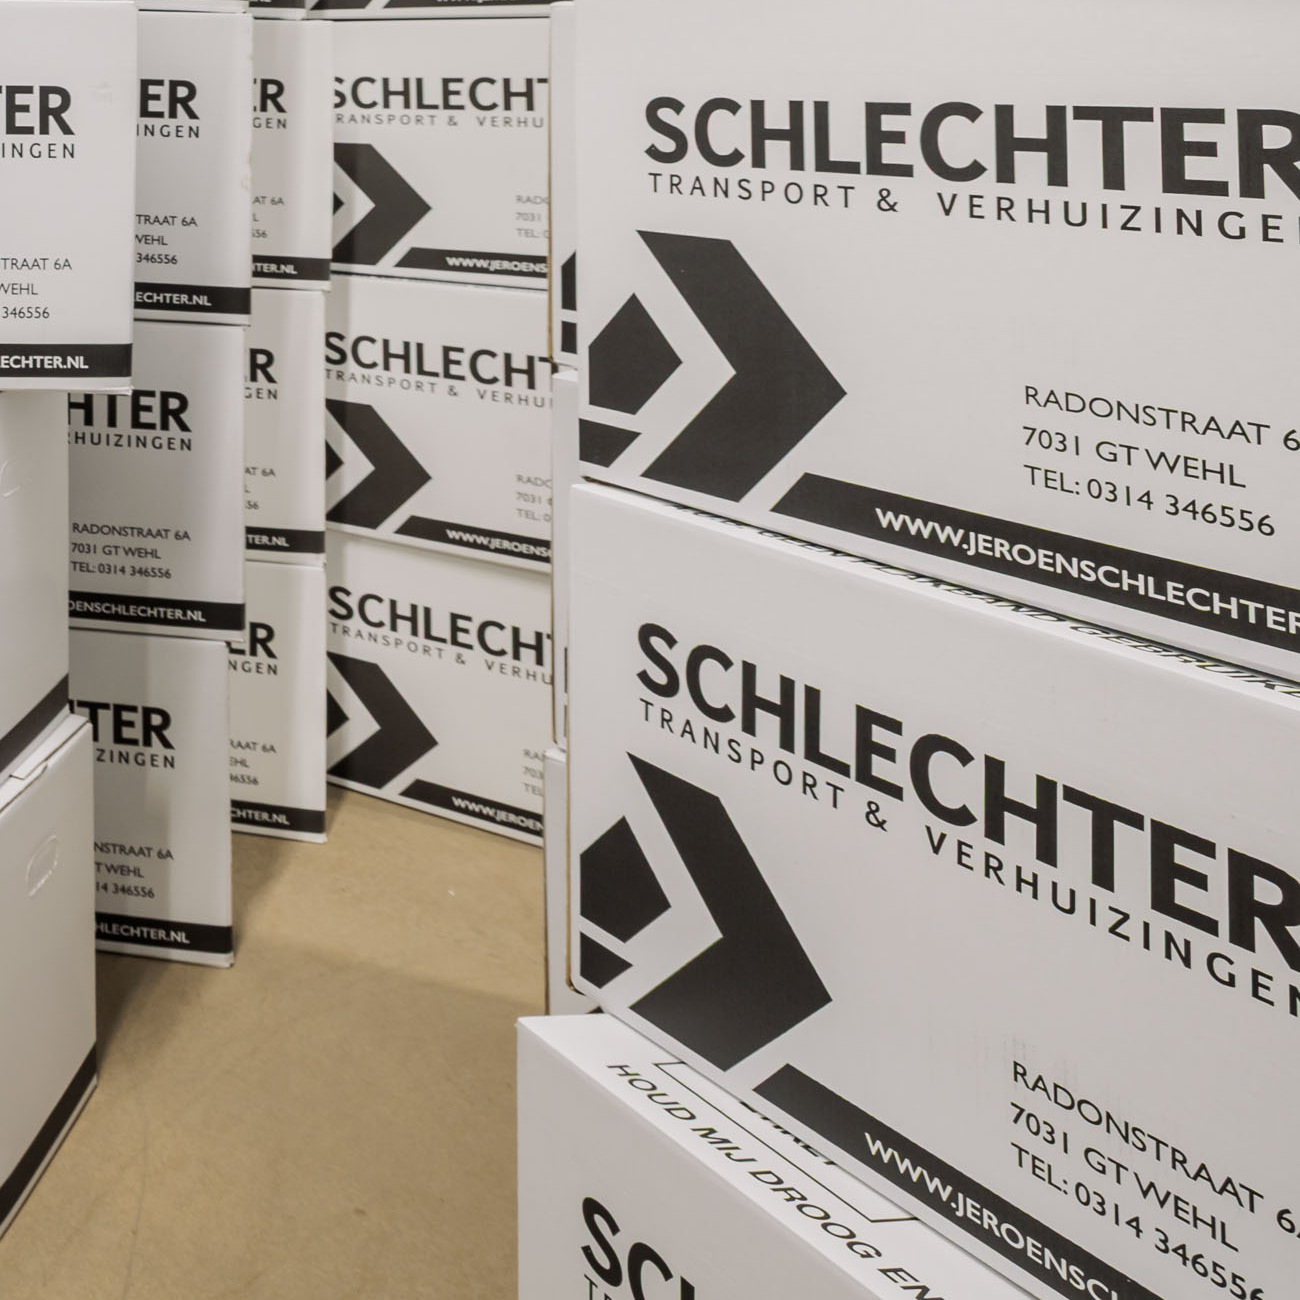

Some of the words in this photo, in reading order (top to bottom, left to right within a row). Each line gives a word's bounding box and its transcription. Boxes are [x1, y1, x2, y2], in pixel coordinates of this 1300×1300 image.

[335, 113, 438, 126] RANSPORT
[648, 172, 855, 208] TRANSPORT
[877, 188, 898, 212] &
[937, 192, 1300, 243] VERHUIZINGE
[53, 258, 72, 270] 6A
[2, 306, 49, 319] 346556
[324, 331, 551, 390] SCHLECH
[70, 431, 192, 452] HUIZINGEN
[1027, 385, 1269, 444] RADONSTRAAT
[1025, 426, 1080, 454] 7031
[1096, 440, 1139, 465] GT
[1146, 449, 1243, 487] WEHL
[1024, 464, 1078, 494] TEL:
[1087, 478, 1152, 509] 0314
[1166, 493, 1272, 535] 346556
[71, 542, 96, 554] 7031
[123, 546, 160, 558] WEHL
[72, 522, 170, 538] RADONSTRAAT
[174, 530, 190, 540] 6A
[98, 563, 126, 574] 0314
[131, 565, 171, 578] 346556
[328, 585, 552, 667] SCHLECH
[329, 622, 445, 660] TRANSPORT
[638, 697, 843, 806] TRANSPORT
[866, 800, 887, 829] &
[637, 623, 1300, 973] SCHLECHTER
[94, 841, 154, 858] NSTRAAT
[606, 1064, 697, 1121] HOUD
[690, 1126, 758, 1164] MIJ
[748, 1169, 882, 1259] DROOG
[1013, 1061, 1264, 1213] RADONSTRAAT
[1013, 1102, 1069, 1153] 7031
[1085, 1147, 1128, 1184] GT
[1134, 1171, 1239, 1252] WEHL
[1075, 1182, 1143, 1239] 0314
